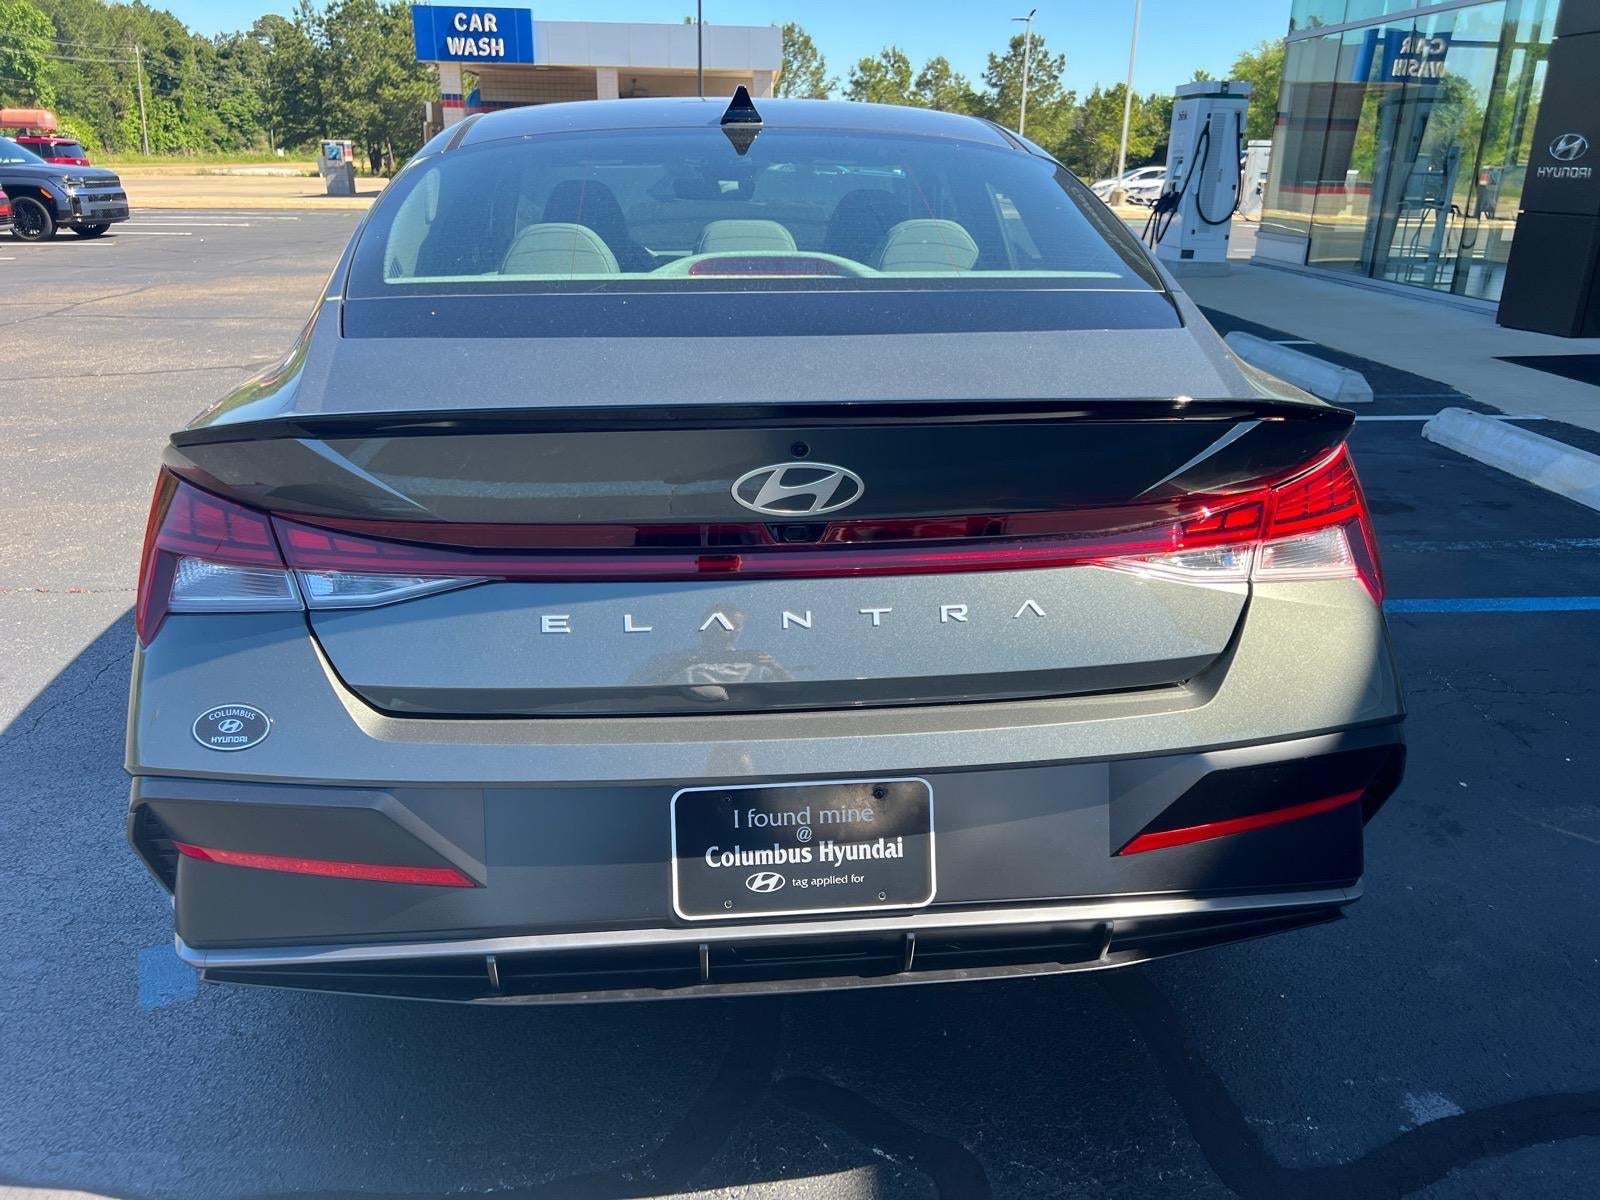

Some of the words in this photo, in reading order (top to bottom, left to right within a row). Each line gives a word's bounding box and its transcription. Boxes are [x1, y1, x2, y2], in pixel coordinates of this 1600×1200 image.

[454, 12, 498, 32] CAR
[446, 36, 505, 57] WASH
[1537, 166, 1592, 179] HYUNDAI
[540, 599, 1046, 634] ELANTRA
[208, 709, 256, 721] COLUMBUS
[734, 809, 739, 828] I
[747, 806, 811, 828] found
[819, 805, 875, 825] mine
[796, 827, 812, 843] @
[705, 843, 813, 868] Columbus
[819, 836, 904, 867] Hyundai
[792, 877, 809, 888] tag
[811, 874, 848, 887] applied
[851, 874, 865, 884] for
